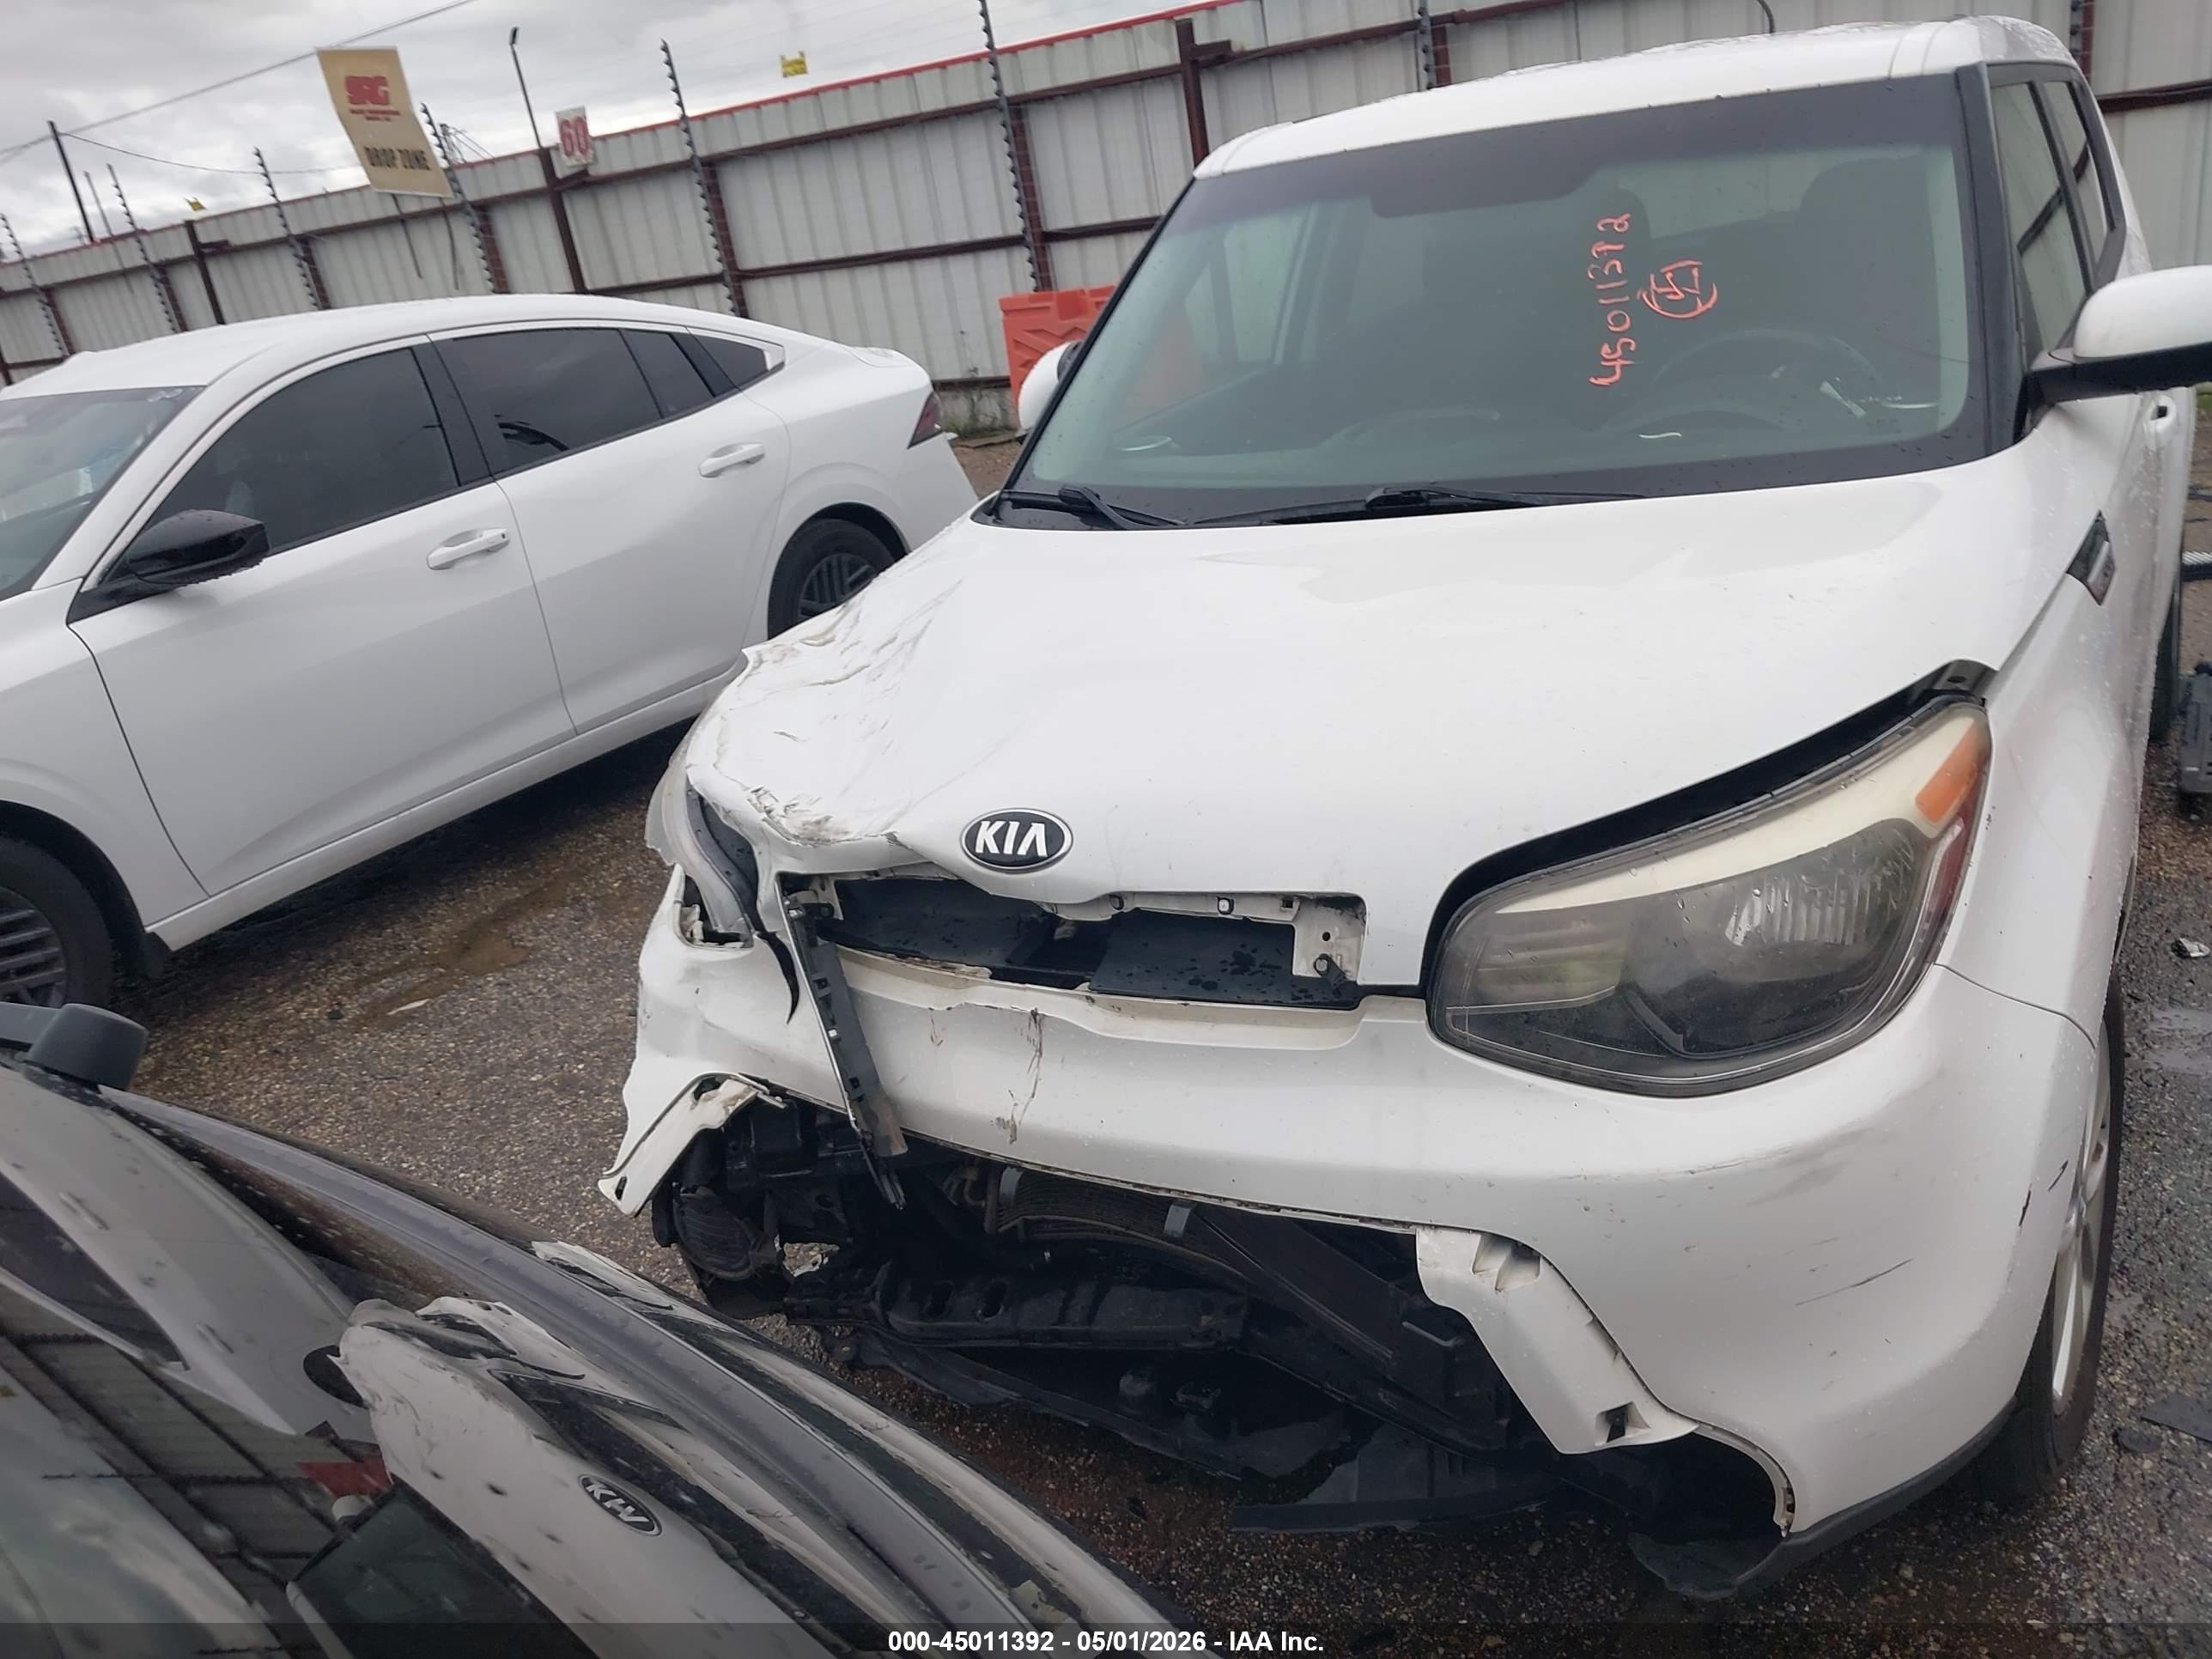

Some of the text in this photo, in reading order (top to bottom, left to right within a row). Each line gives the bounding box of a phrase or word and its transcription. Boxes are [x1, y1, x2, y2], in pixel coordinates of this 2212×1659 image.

[561, 116, 589, 157] 60
[364, 147, 431, 170] DROP ZONE
[975, 820, 1048, 858] KIA
